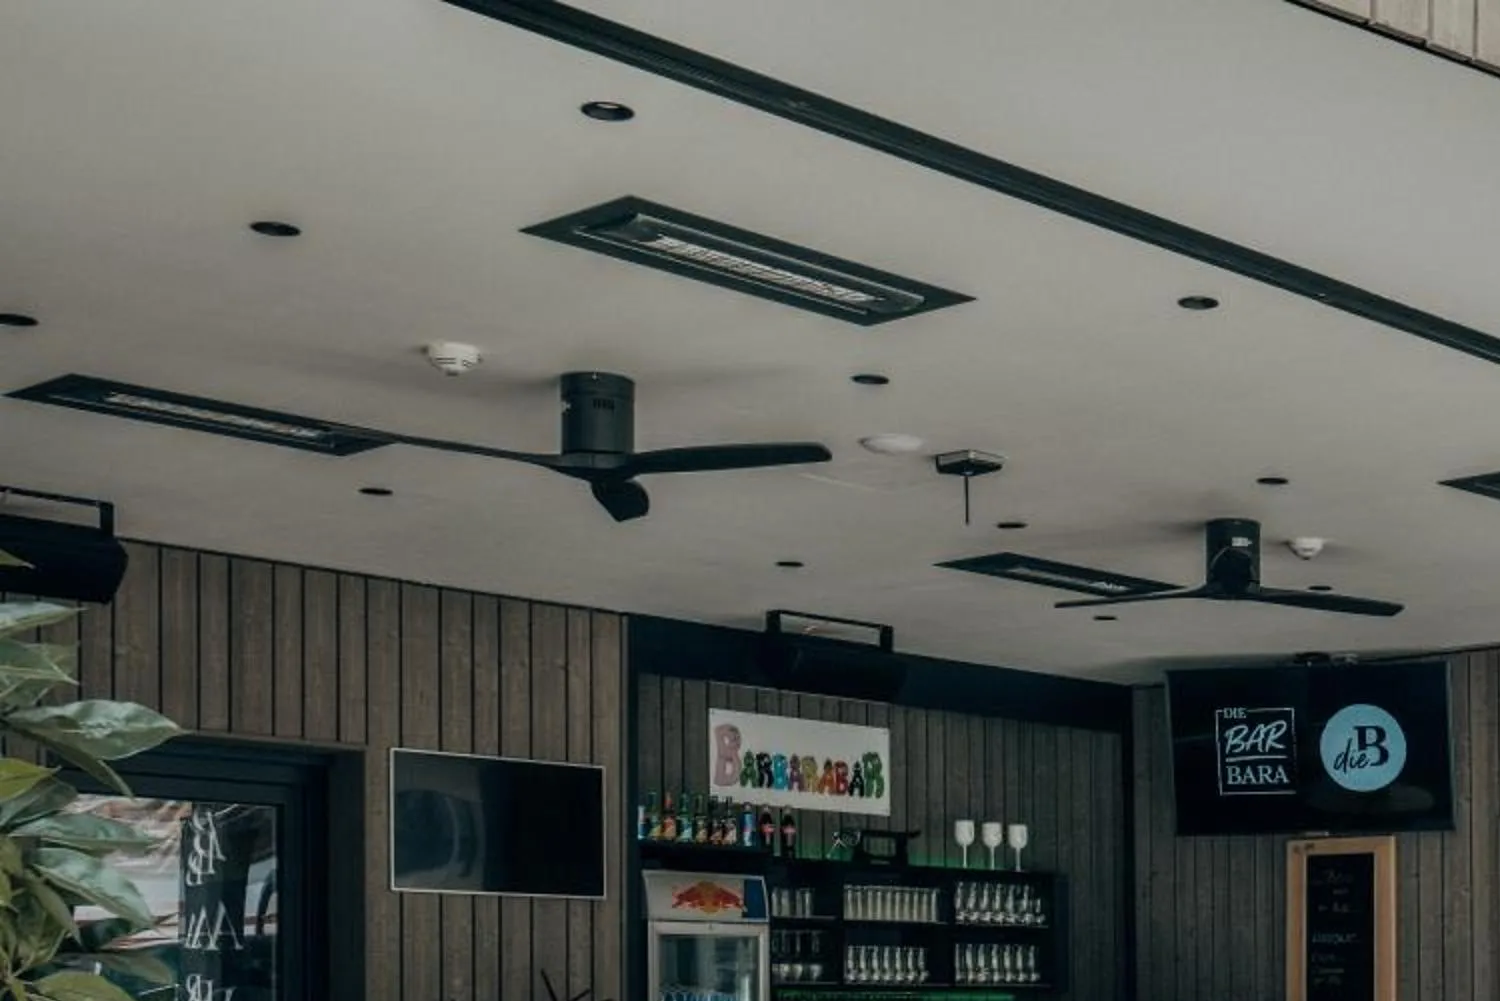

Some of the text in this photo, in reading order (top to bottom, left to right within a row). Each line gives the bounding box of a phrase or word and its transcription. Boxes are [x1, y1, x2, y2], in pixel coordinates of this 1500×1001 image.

[1223, 707, 1247, 719] DIE
[1224, 719, 1287, 754] BAR
[1333, 725, 1389, 774] die B
[1227, 764, 1290, 785] BARA
